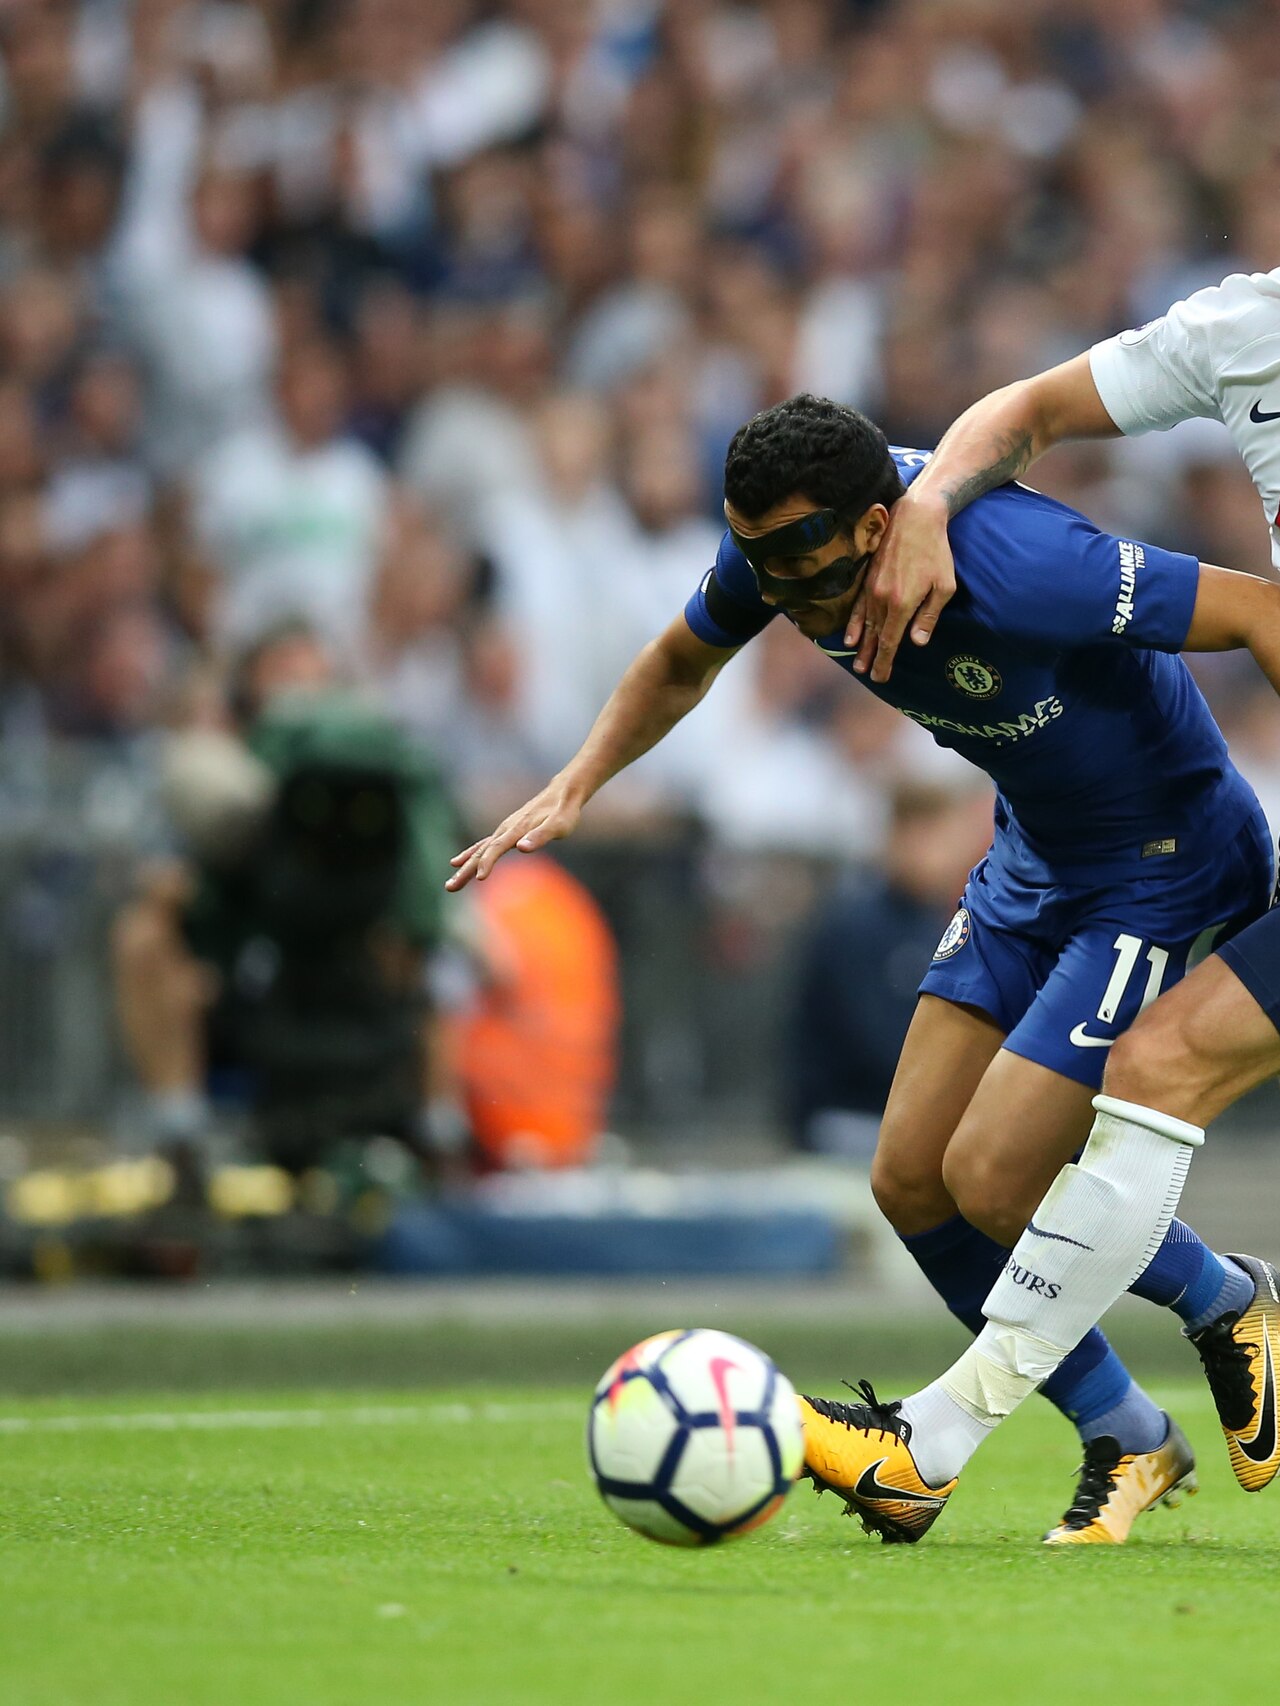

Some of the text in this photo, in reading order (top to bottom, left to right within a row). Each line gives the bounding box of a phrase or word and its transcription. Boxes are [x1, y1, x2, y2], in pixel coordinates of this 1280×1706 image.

[1134, 544, 1146, 569] TYRES
[1116, 541, 1135, 620] ALLIANCE
[948, 655, 980, 669] CHELSEA
[1096, 933, 1169, 1031] 11
[1004, 1256, 1062, 1299] PURS
